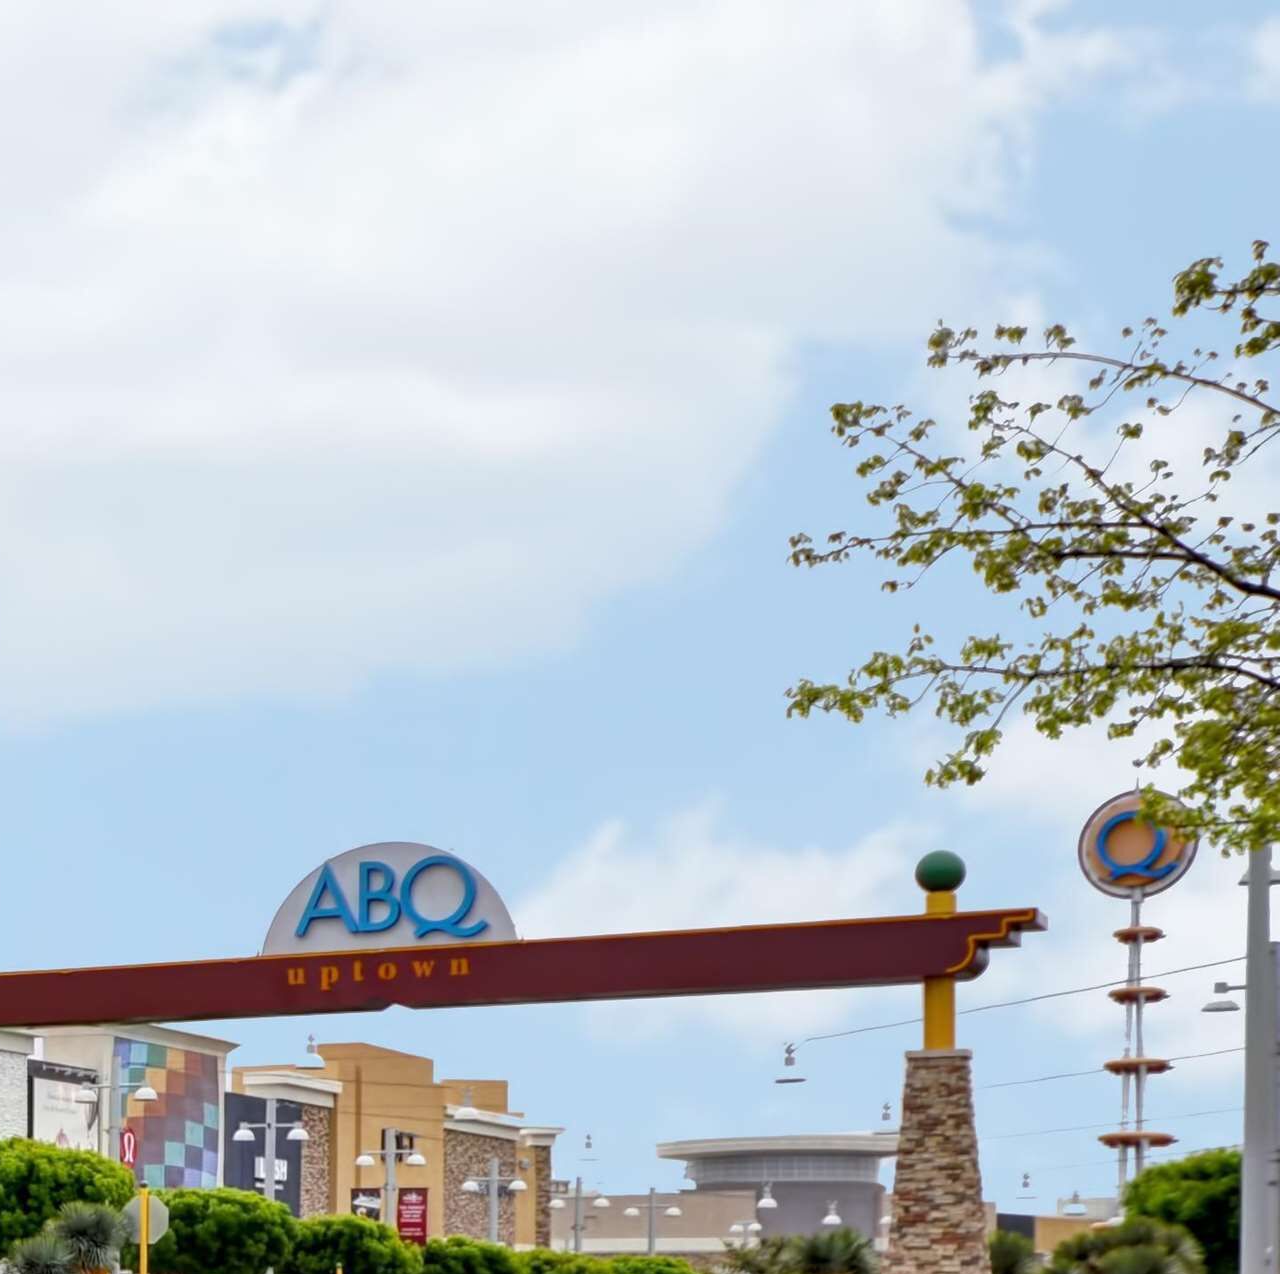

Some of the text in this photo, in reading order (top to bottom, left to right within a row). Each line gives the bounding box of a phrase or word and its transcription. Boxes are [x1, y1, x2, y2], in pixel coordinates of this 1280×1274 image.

[1096, 811, 1178, 881] Q
[295, 854, 490, 938] ABQ
[287, 956, 471, 992] uptown
[254, 1156, 288, 1182] LSH
